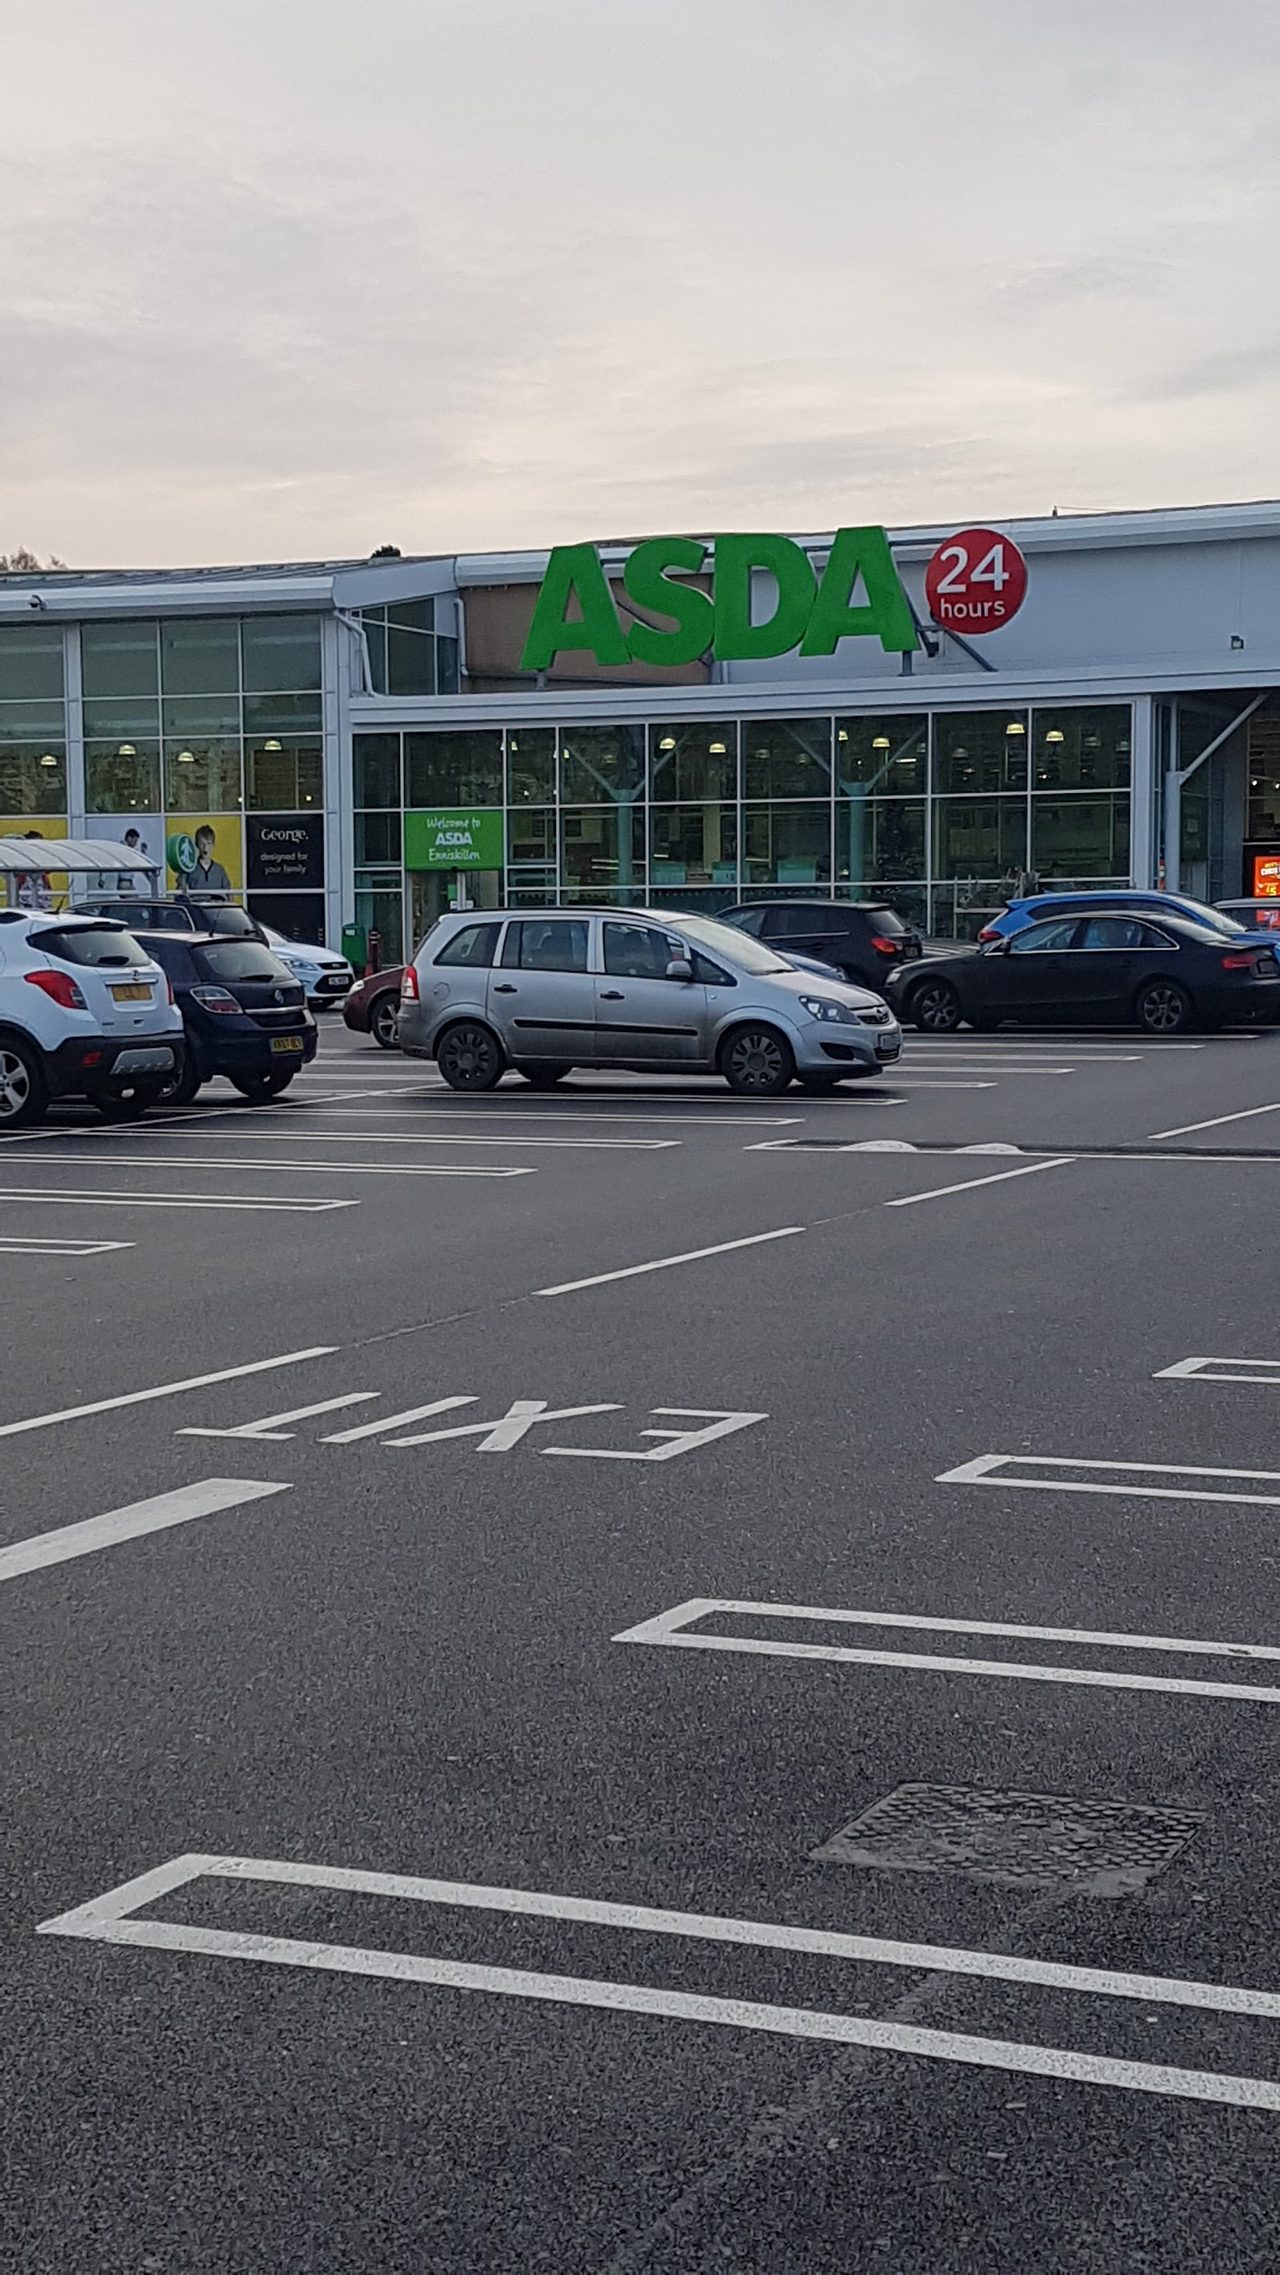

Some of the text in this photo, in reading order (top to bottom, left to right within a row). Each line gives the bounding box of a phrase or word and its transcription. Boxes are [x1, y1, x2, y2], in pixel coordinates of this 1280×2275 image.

[936, 543, 1010, 594] 24
[520, 525, 921, 671] ASDA
[940, 598, 1005, 618] hours
[426, 816, 481, 829] Welcome to
[261, 828, 309, 843] George.
[435, 832, 473, 845] ASDA
[260, 852, 308, 863] designed for
[428, 848, 480, 861] Enniskillen
[264, 864, 306, 875] your family
